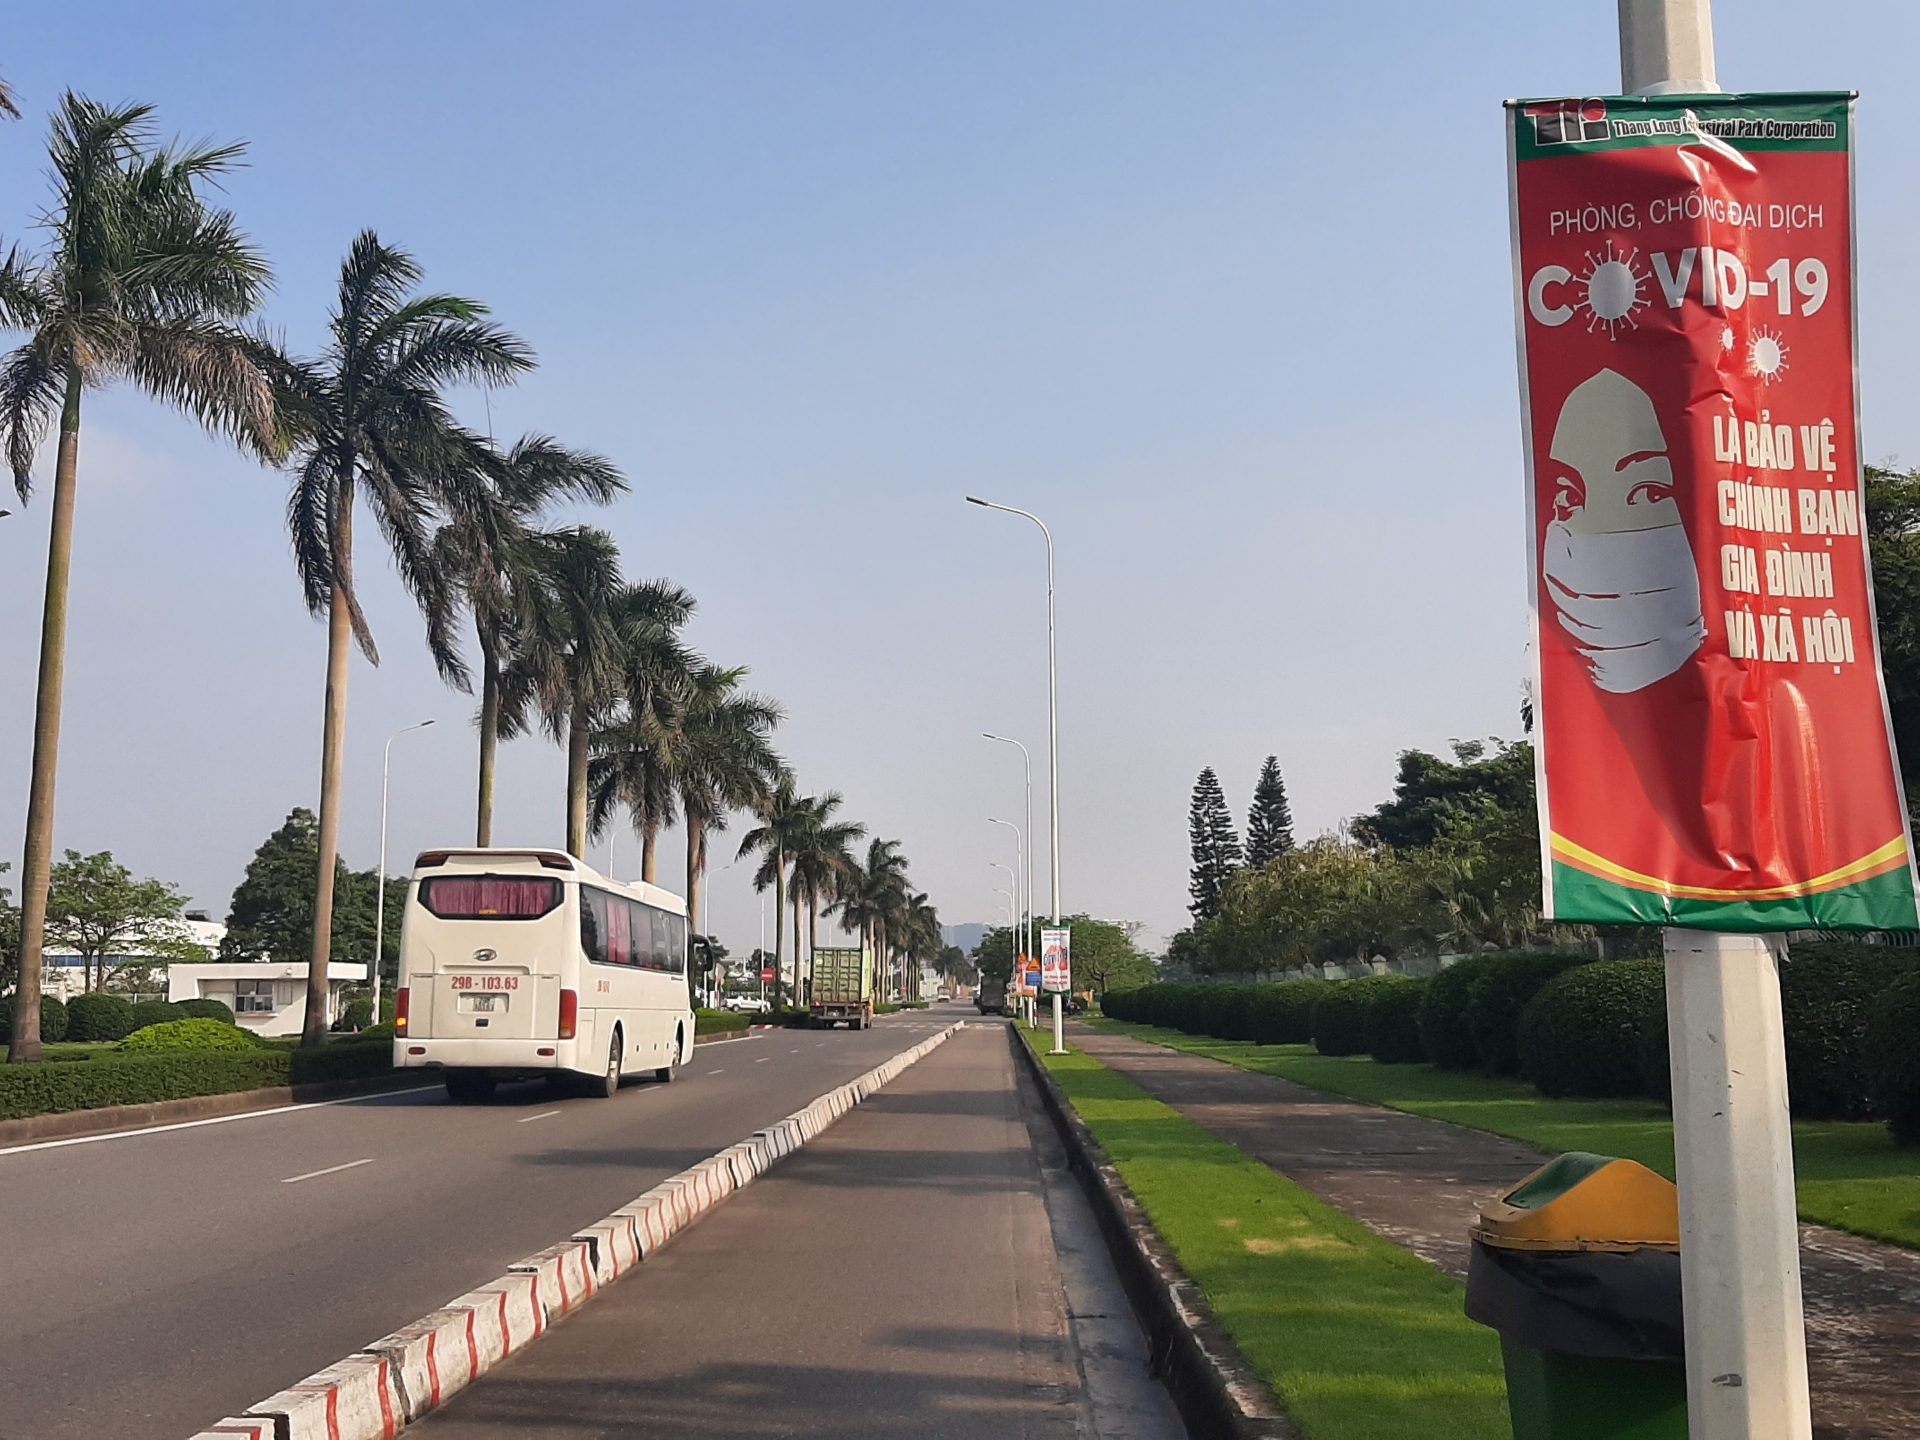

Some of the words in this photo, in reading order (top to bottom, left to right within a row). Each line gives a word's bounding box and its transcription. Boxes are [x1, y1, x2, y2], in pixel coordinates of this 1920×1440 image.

[1613, 120, 1651, 136] Thang
[1652, 118, 1682, 135] Long
[1738, 119, 1764, 137] Park
[1766, 120, 1835, 139] Corporation
[1550, 202, 1642, 236] PHÒNG,
[1650, 186, 1726, 224] CHỐNG
[1727, 201, 1763, 231] ĐẠI
[1769, 204, 1824, 234] DỊCH
[1713, 407, 1742, 464] LÀ
[1744, 409, 1795, 470] BẢO
[1800, 418, 1837, 482] VỆ
[1717, 477, 1792, 534] CHÍNH
[1798, 489, 1858, 546] BẠN
[1721, 544, 1760, 595] GIA
[1765, 542, 1834, 598] ĐÌNH
[1725, 604, 1758, 660] VÀ
[1760, 607, 1799, 663] XÃ
[1802, 608, 1855, 674] HỘI
